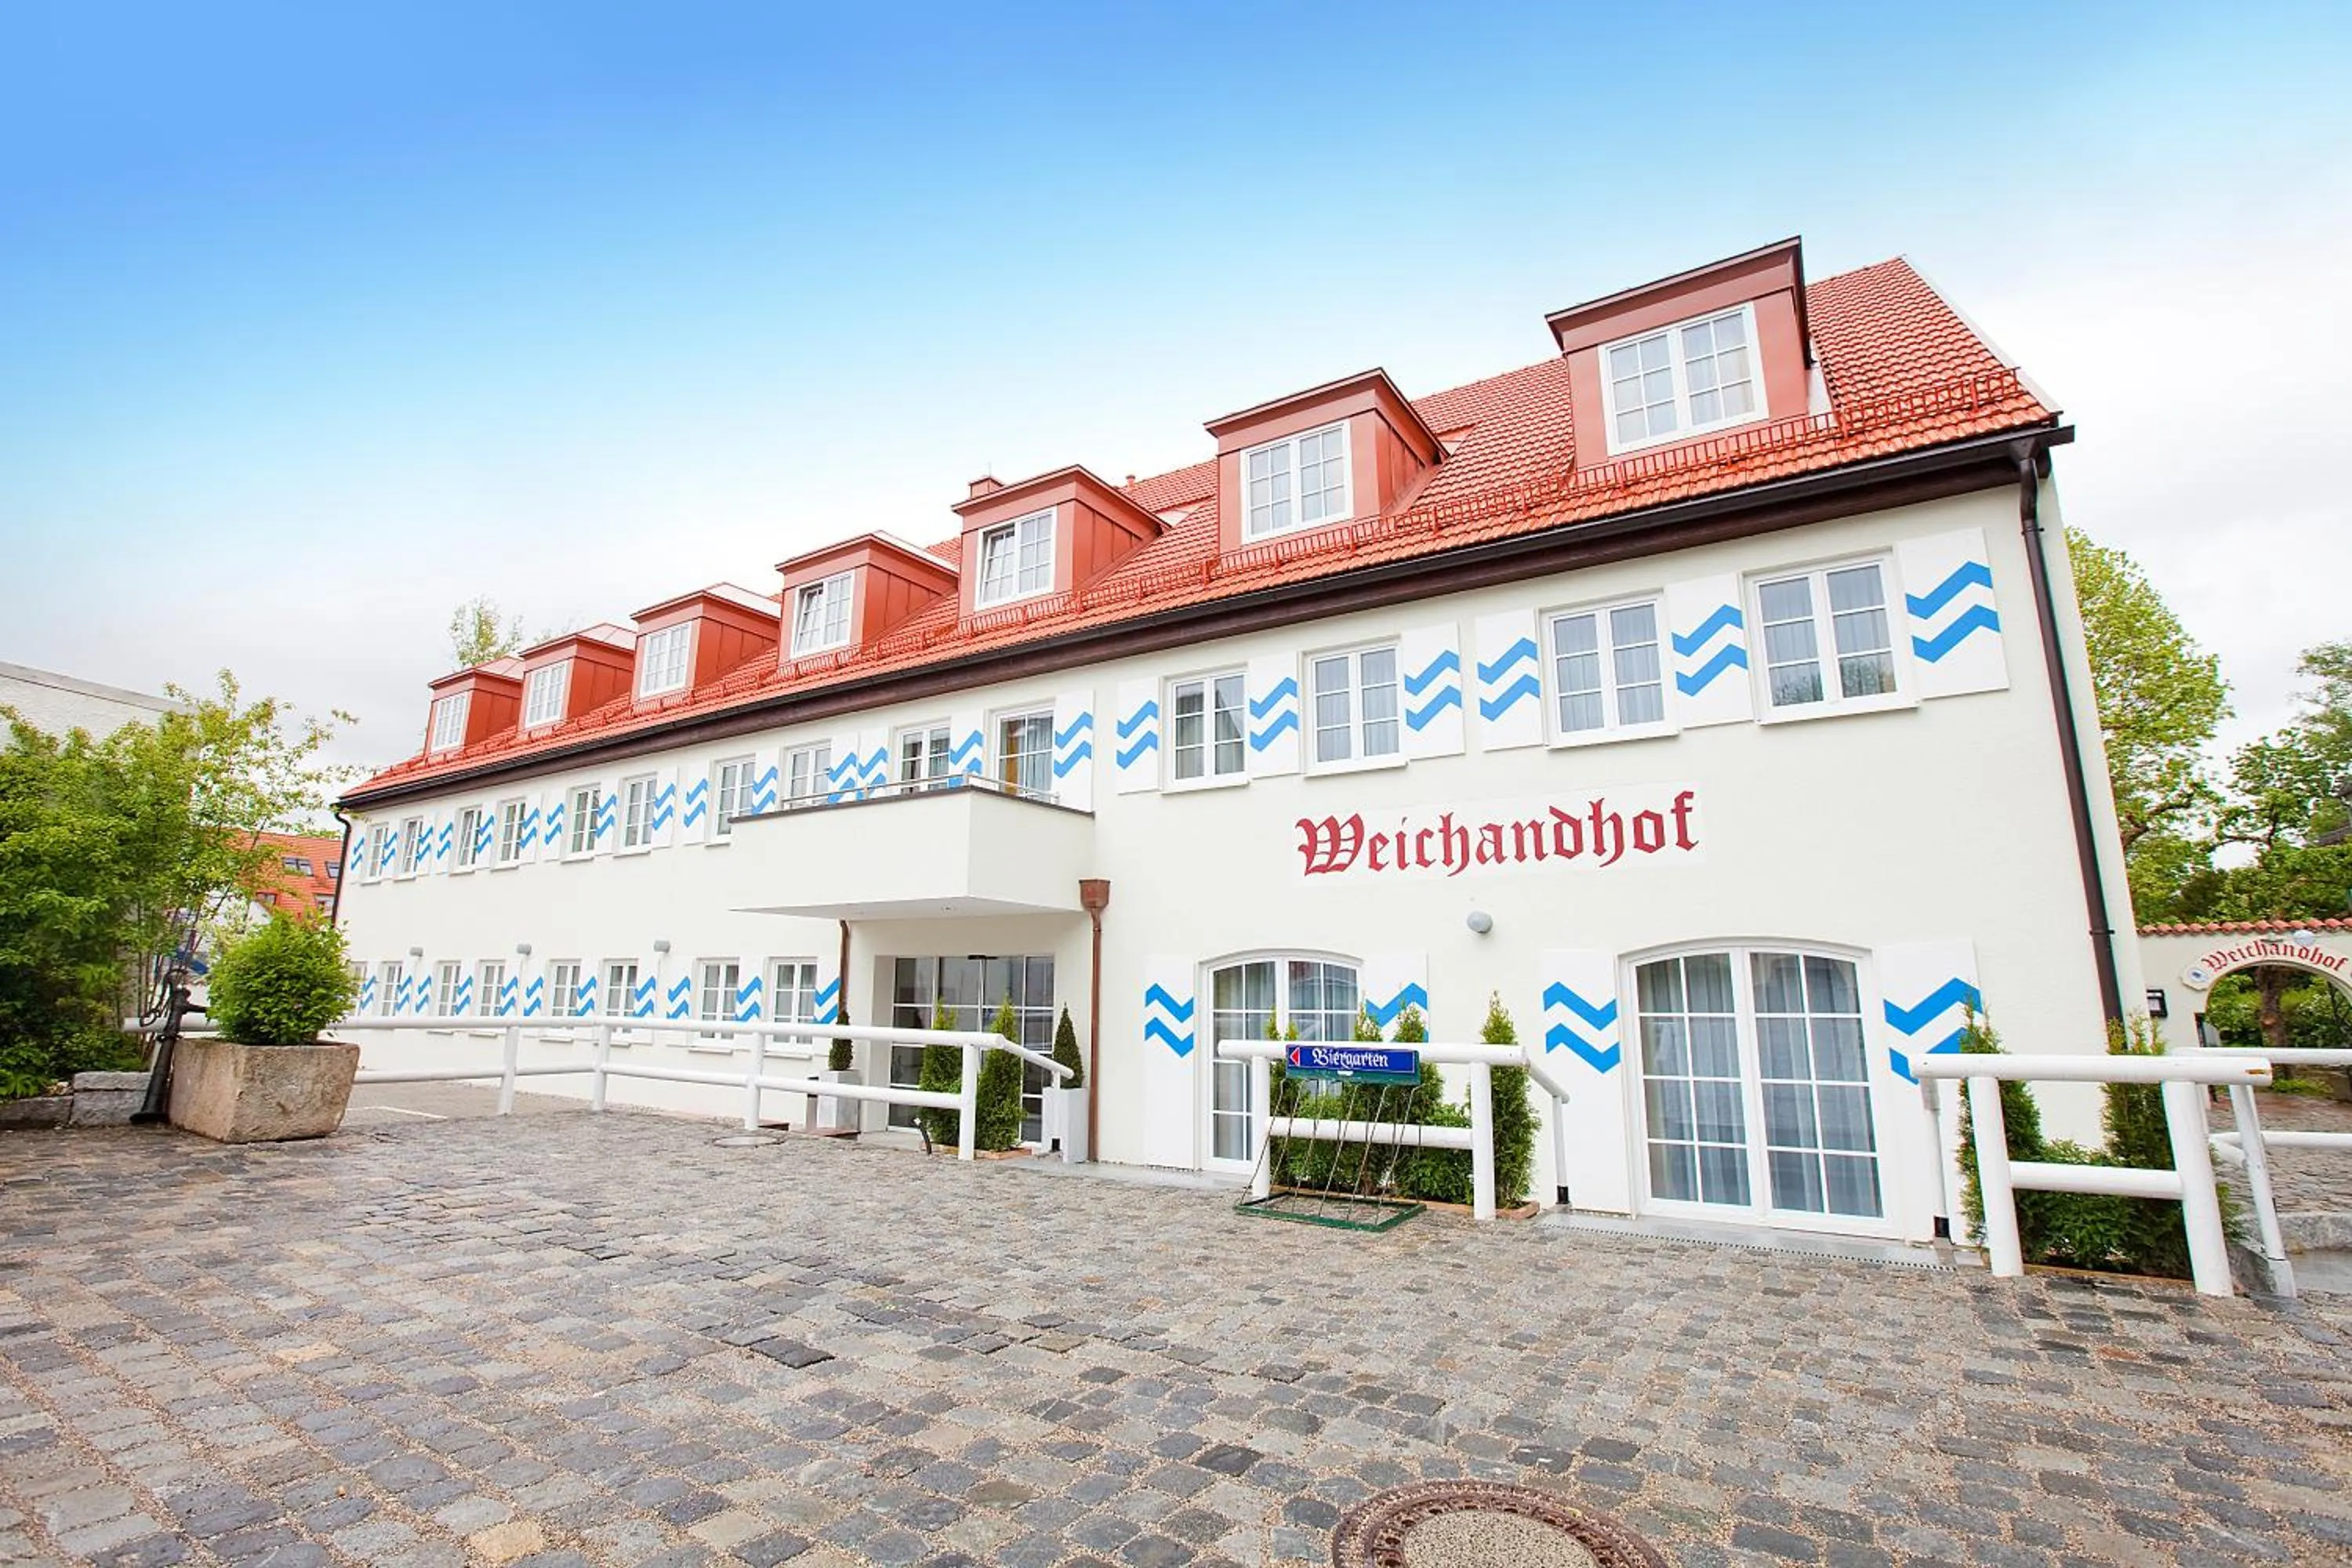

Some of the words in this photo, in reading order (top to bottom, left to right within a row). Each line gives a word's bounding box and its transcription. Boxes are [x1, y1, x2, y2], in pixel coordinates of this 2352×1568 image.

[1295, 790, 1699, 877] Weichandhof
[2201, 939, 2348, 972] Weichandhof
[1312, 1047, 1388, 1068] Biergarten
